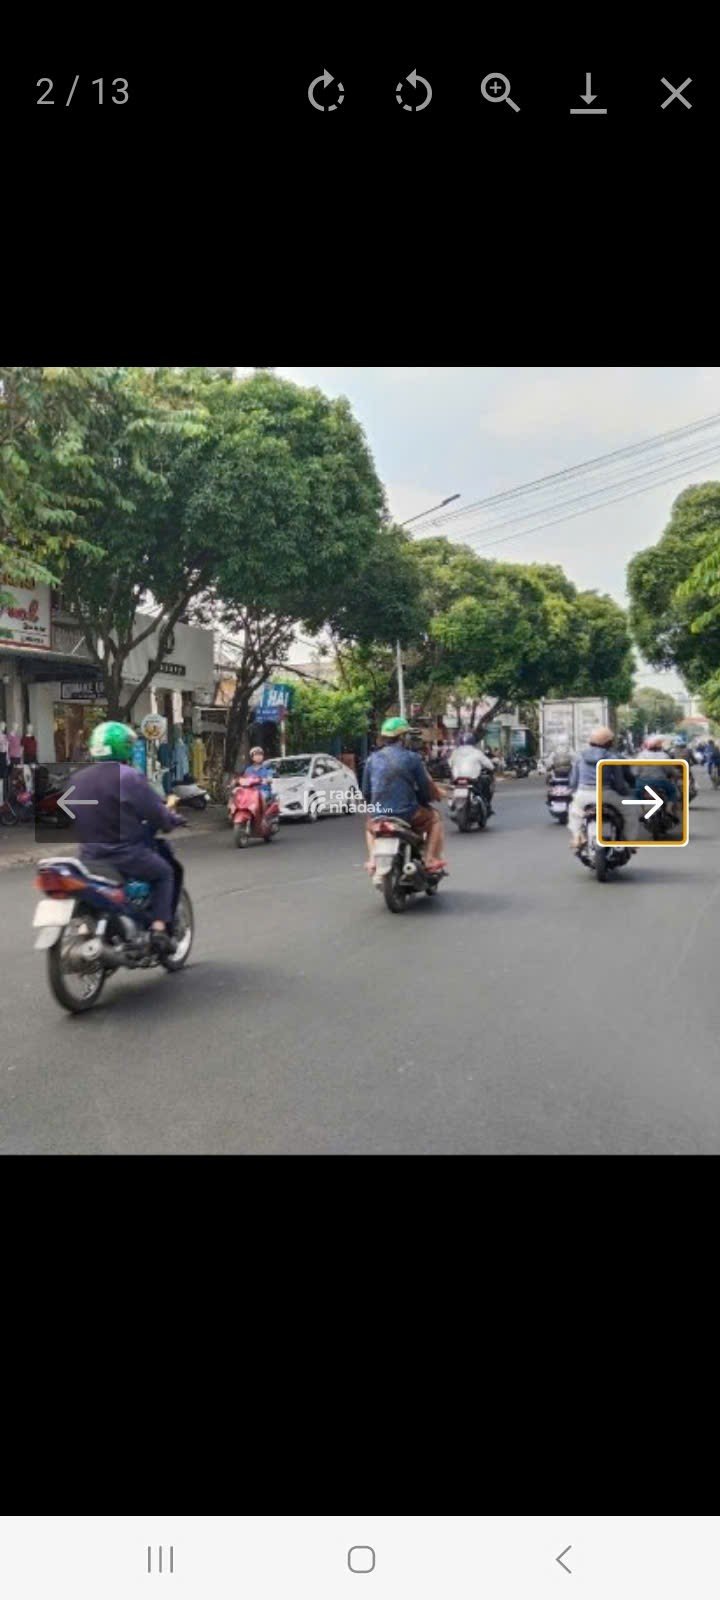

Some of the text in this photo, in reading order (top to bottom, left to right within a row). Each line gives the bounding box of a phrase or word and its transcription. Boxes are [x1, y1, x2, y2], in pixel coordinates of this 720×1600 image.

[36, 75, 129, 107] 2 / 13
